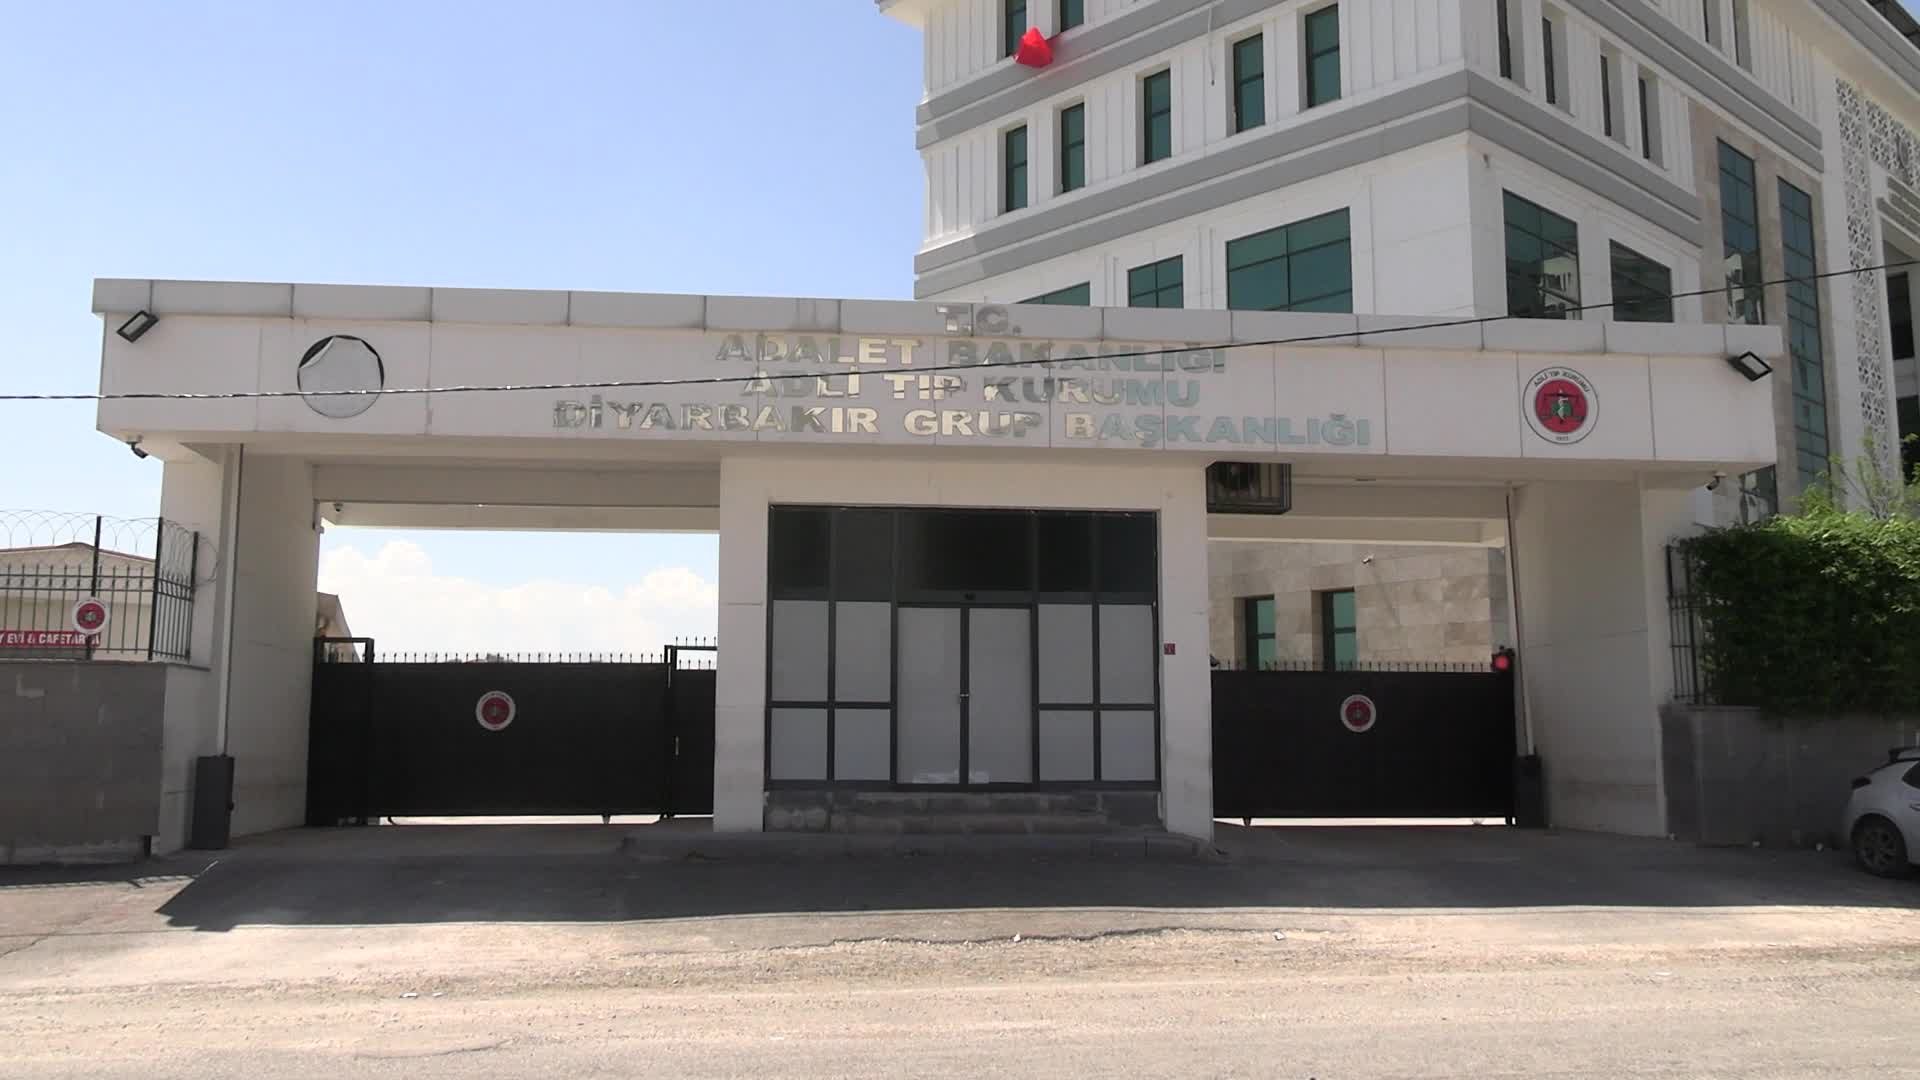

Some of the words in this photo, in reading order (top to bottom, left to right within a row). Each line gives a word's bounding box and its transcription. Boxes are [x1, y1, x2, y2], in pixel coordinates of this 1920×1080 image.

[715, 333, 921, 365] ADALET
[948, 340, 1226, 374] BAKANLIĞI
[740, 366, 861, 399] ADLİ
[882, 373, 966, 400] TIP
[984, 375, 1200, 407] KURUMU
[552, 394, 880, 433] DİYARBAKIR
[903, 408, 1044, 438] GRUP
[1065, 411, 1371, 450] BAŞKANLIĞI
